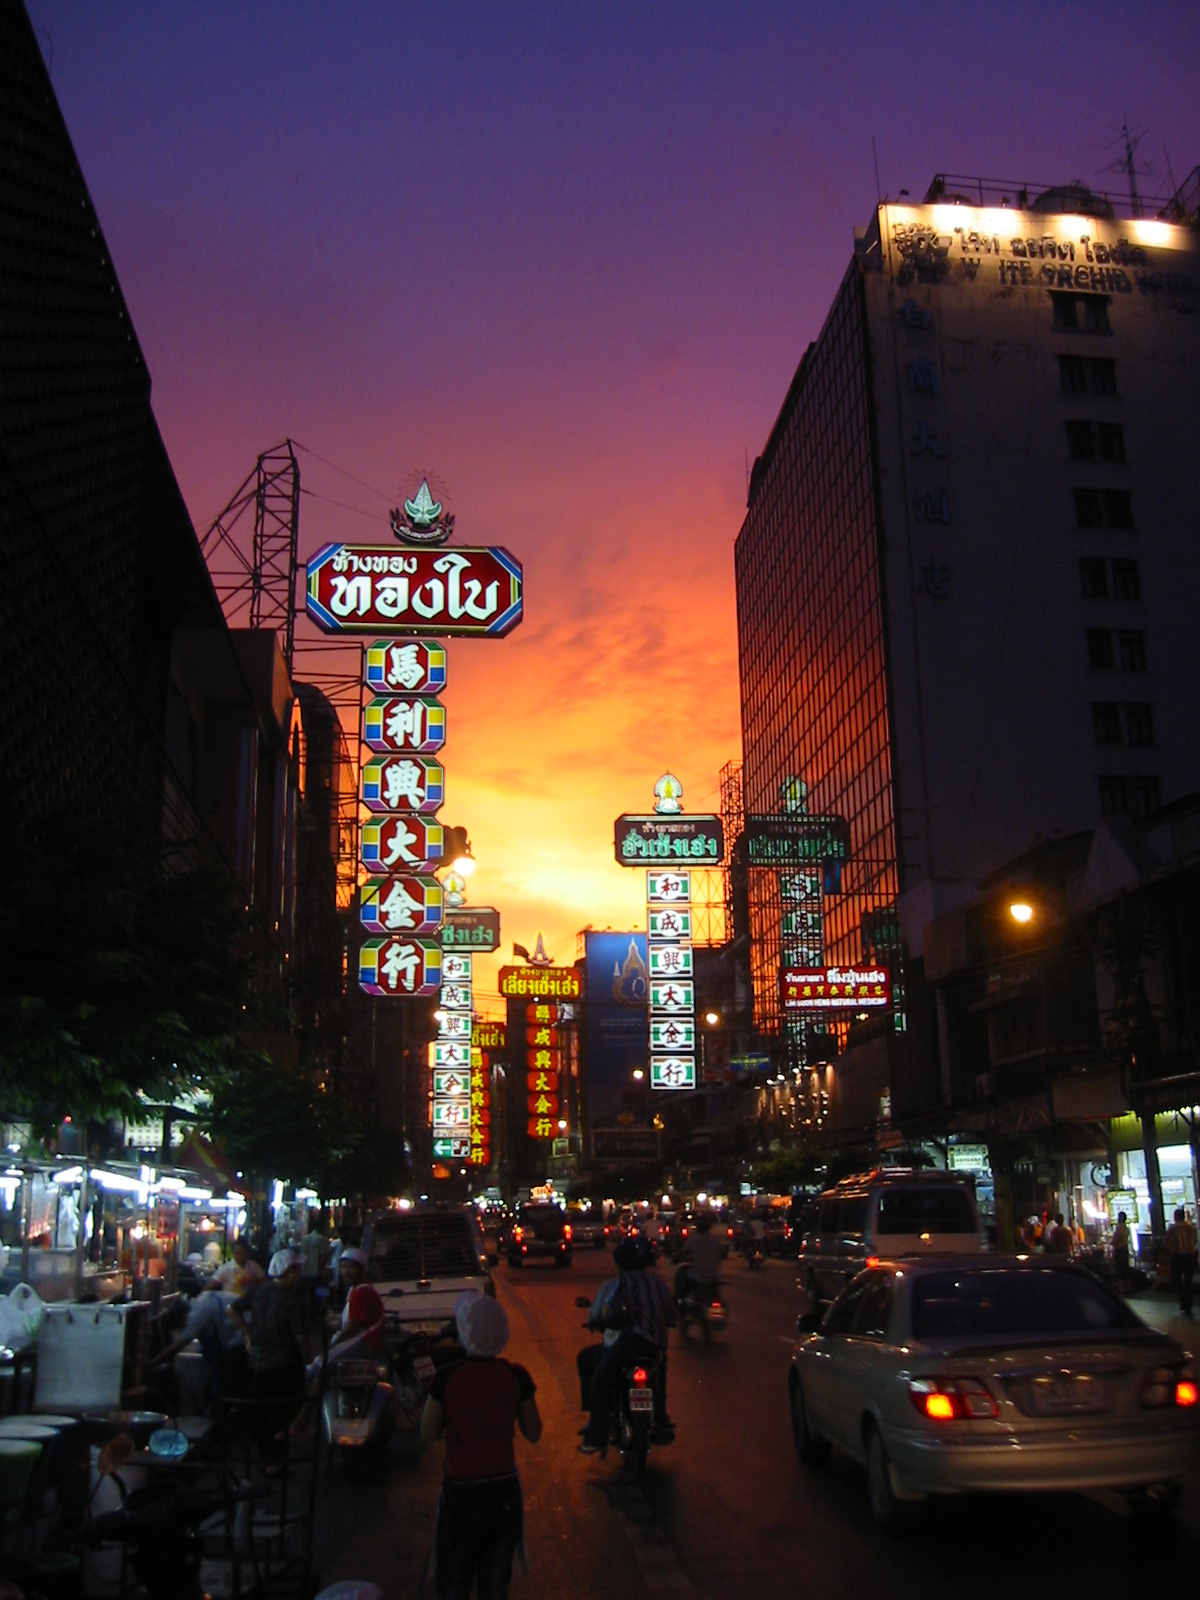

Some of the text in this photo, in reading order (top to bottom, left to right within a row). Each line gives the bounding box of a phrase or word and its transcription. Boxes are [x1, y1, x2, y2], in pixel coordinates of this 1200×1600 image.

[960, 257, 1034, 286] WITE
[1041, 262, 1134, 294] ORCHID
[329, 553, 500, 621] ทองใบ
[332, 549, 418, 575] ห้างทอง
[380, 643, 426, 992] 馬利興大金行
[660, 875, 684, 1085] 和成興大金行
